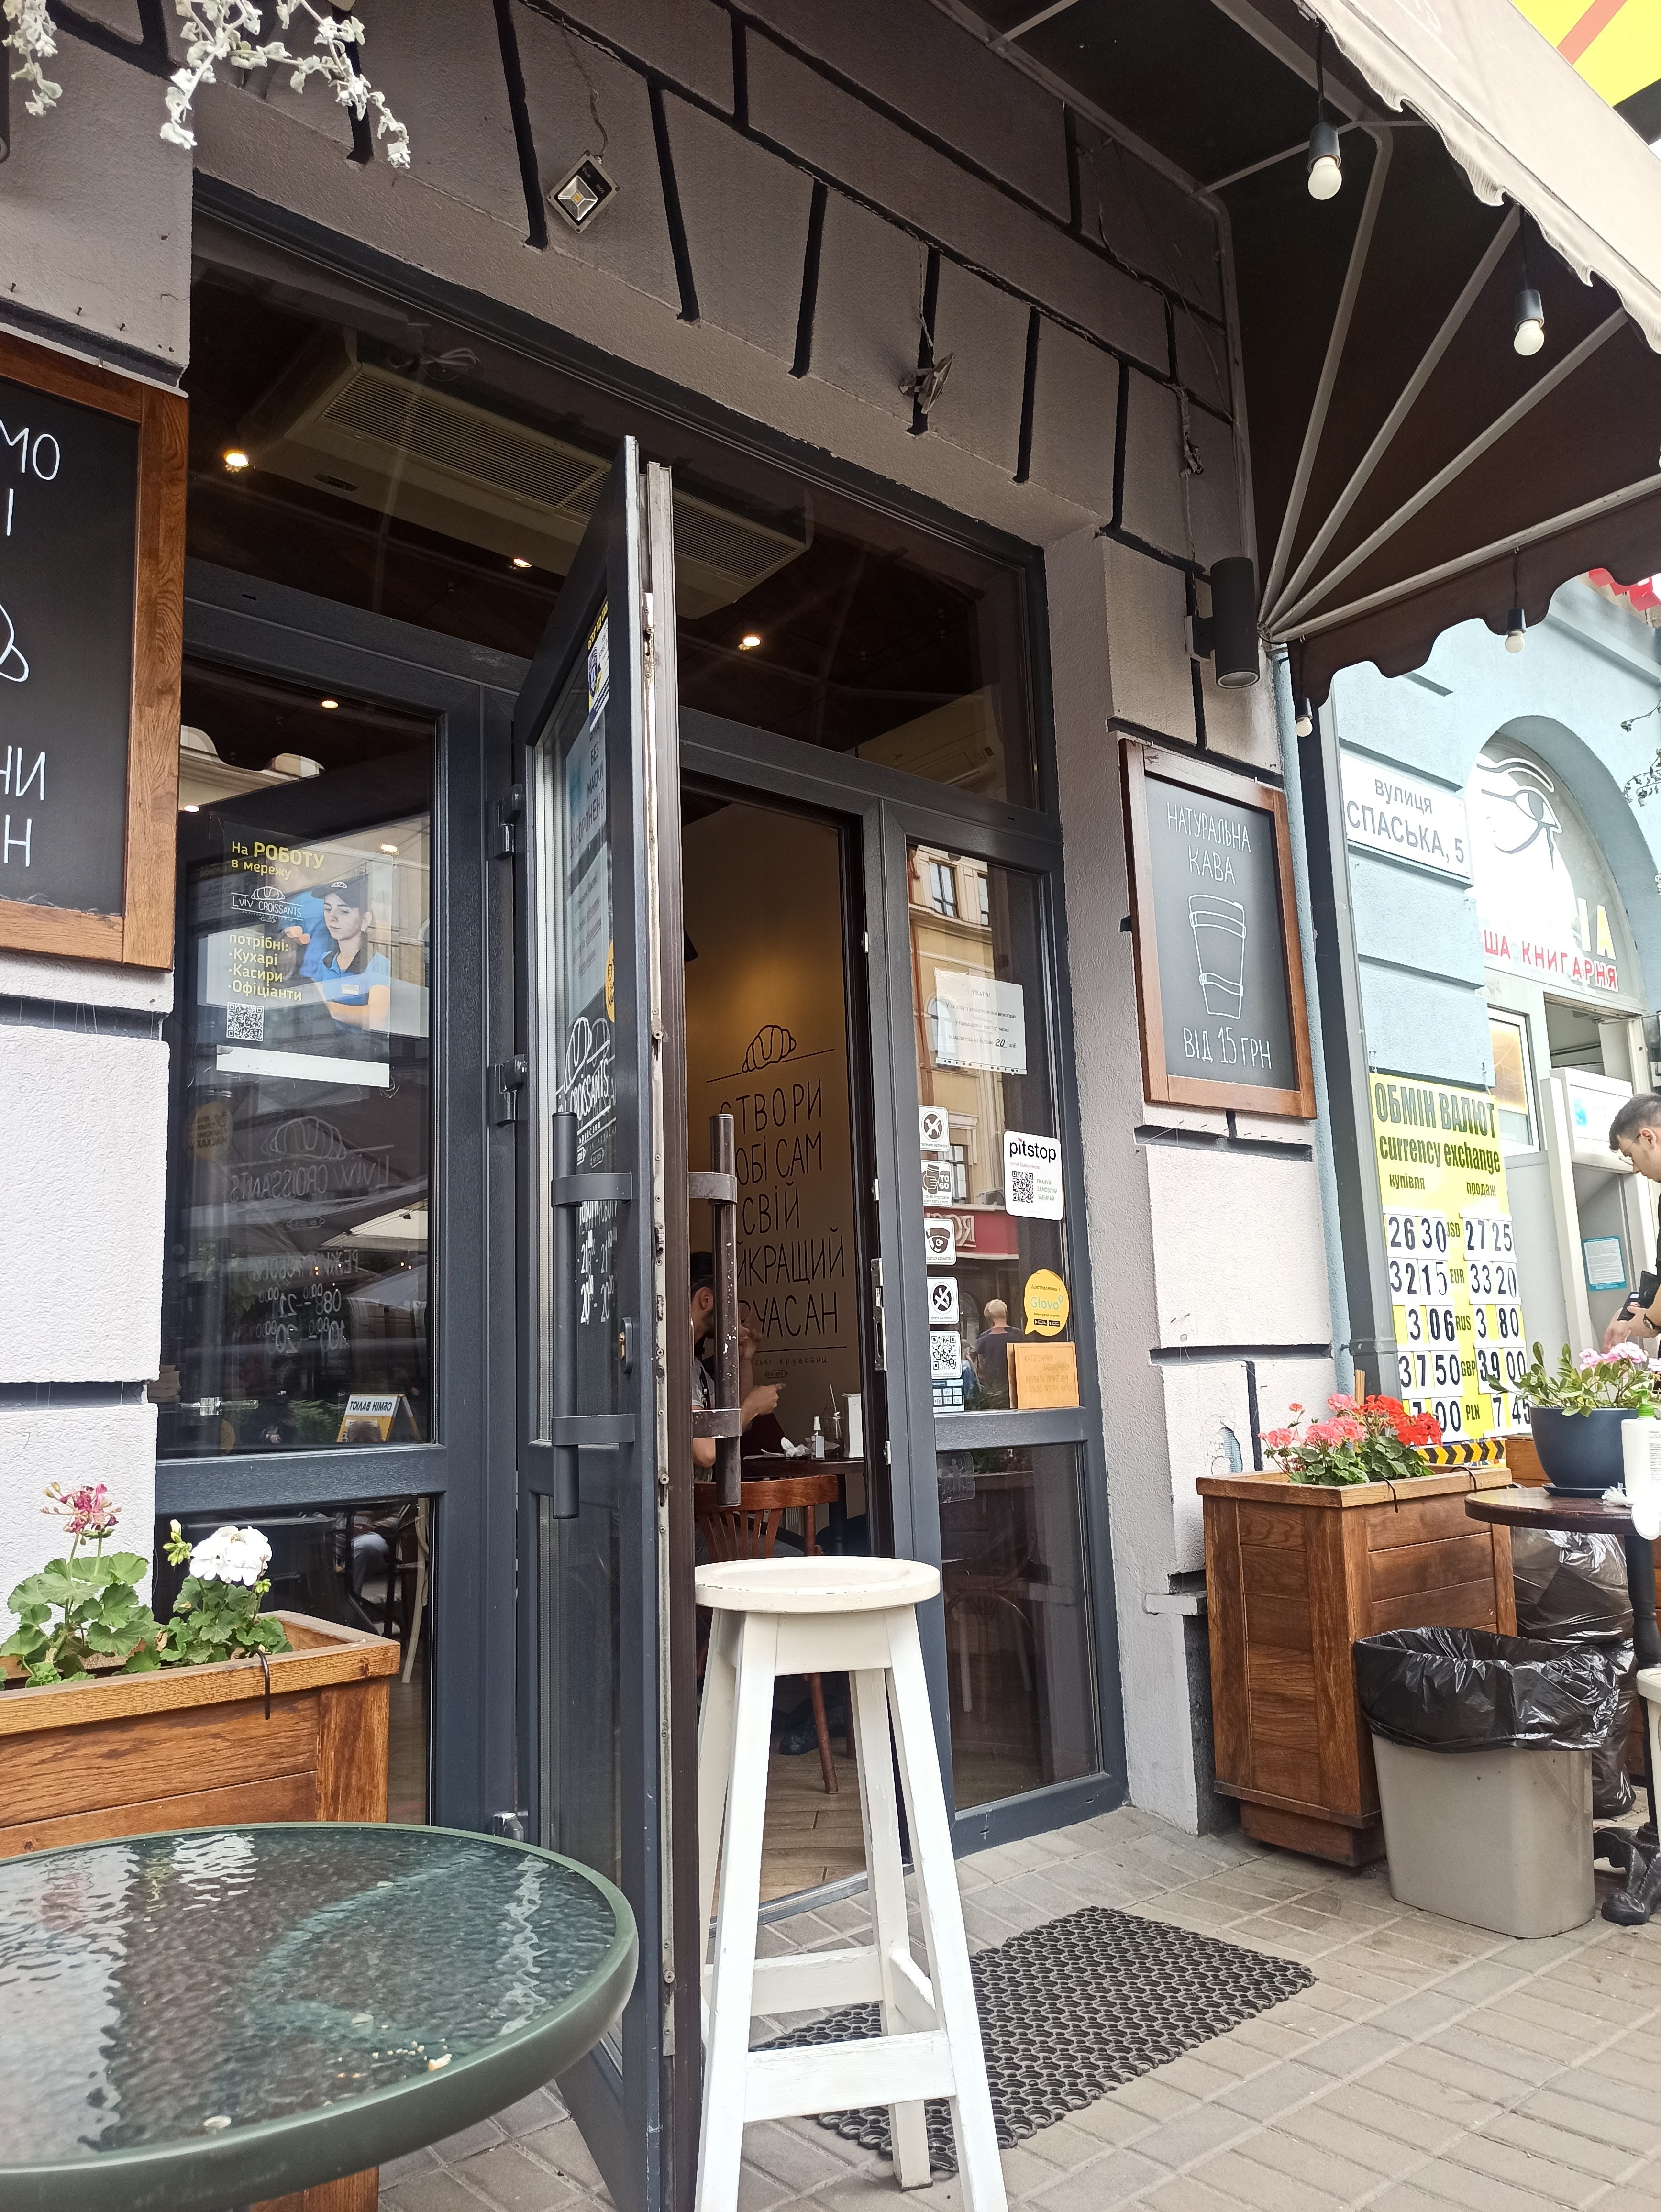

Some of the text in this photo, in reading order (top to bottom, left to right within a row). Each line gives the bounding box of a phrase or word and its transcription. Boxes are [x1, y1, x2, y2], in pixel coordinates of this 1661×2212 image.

[590, 740, 599, 767] БЕЗ
[587, 761, 604, 798] МАСКИ
[1374, 779, 1432, 814] вулиця
[1166, 802, 1251, 853] НАТУРАЛЬНА
[1347, 801, 1464, 863] СПАСЬКА, 5
[232, 841, 324, 869] На РОБОТУ
[1188, 846, 1236, 885] КАВА
[232, 858, 291, 881] в мережу
[229, 933, 289, 952] потрібні:
[233, 947, 277, 967] Кухарі
[1481, 929, 1617, 990] ША КНИГАРНЯ
[233, 963, 283, 984] Касири
[232, 979, 302, 1002] Офіціанти
[972, 990, 991, 998] УВАГА!
[995, 1038, 1006, 1047] 20
[1183, 1026, 1272, 1069] ВІД 15 ГРН
[1375, 1082, 1495, 1139] ОБМІН ВАЛЮТ
[735, 1130, 823, 1186] ОБІ САМ
[1009, 1137, 1056, 1163] pitstop
[1379, 1135, 1501, 1175] currency exchange
[1037, 1186, 1058, 1194] ЗАМОВЛЯЙ
[1389, 1173, 1496, 1197] купівля продаж
[742, 1182, 800, 1236] СВІЙ
[1450, 1268, 1465, 1284] EUR
[1030, 1296, 1059, 1310] Glovo
[1456, 1315, 1472, 1331] RUS
[779, 1356, 827, 1367] круасани
[1461, 1360, 1476, 1377] GBP
[1465, 1404, 1481, 1421] PLN
